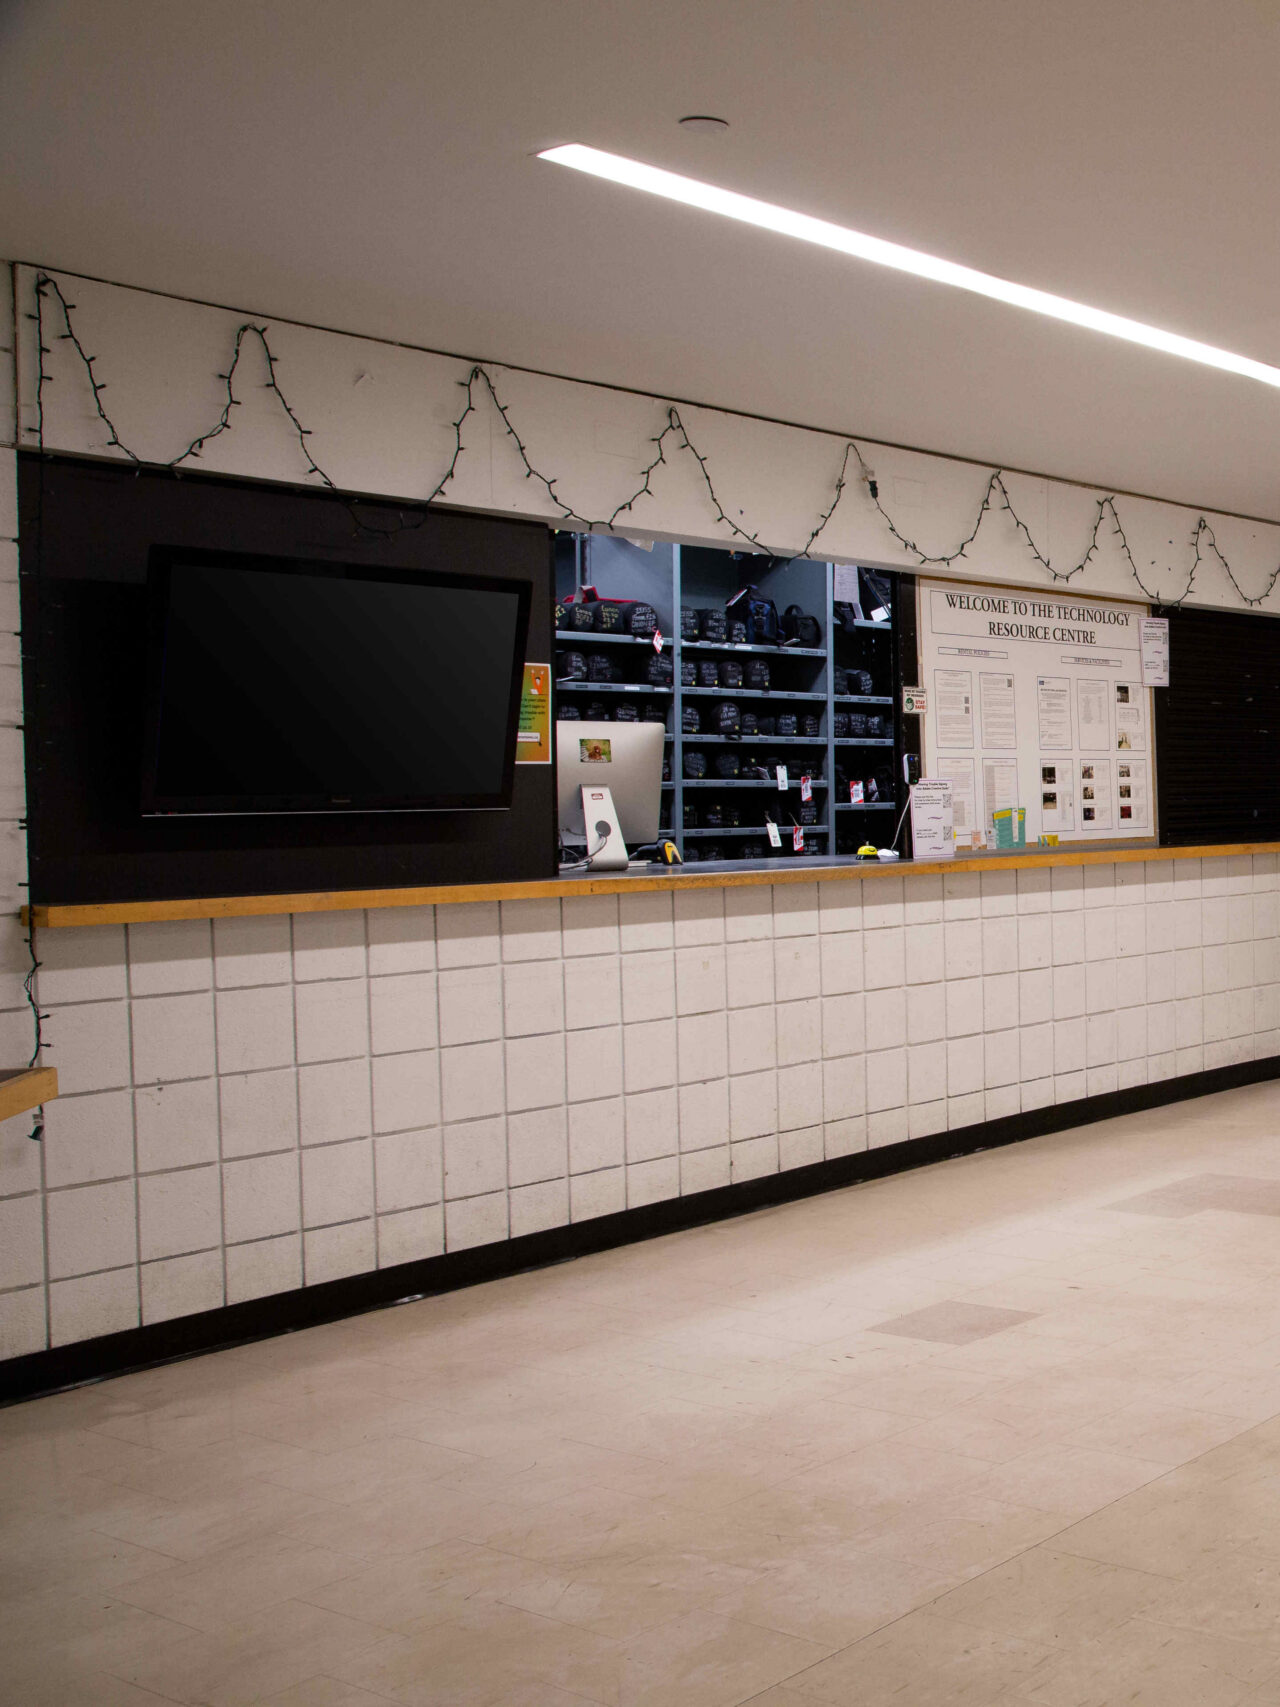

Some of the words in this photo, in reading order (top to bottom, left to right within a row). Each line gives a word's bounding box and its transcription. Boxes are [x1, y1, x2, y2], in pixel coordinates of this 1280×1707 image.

[945, 593, 1010, 614] WELCOME
[1011, 601, 1028, 616] TO
[1030, 602, 1054, 619] THE
[1056, 605, 1131, 627] TECHNOLOGY
[988, 622, 1050, 640] RESOURCE
[1052, 628, 1097, 645] CENTRE
